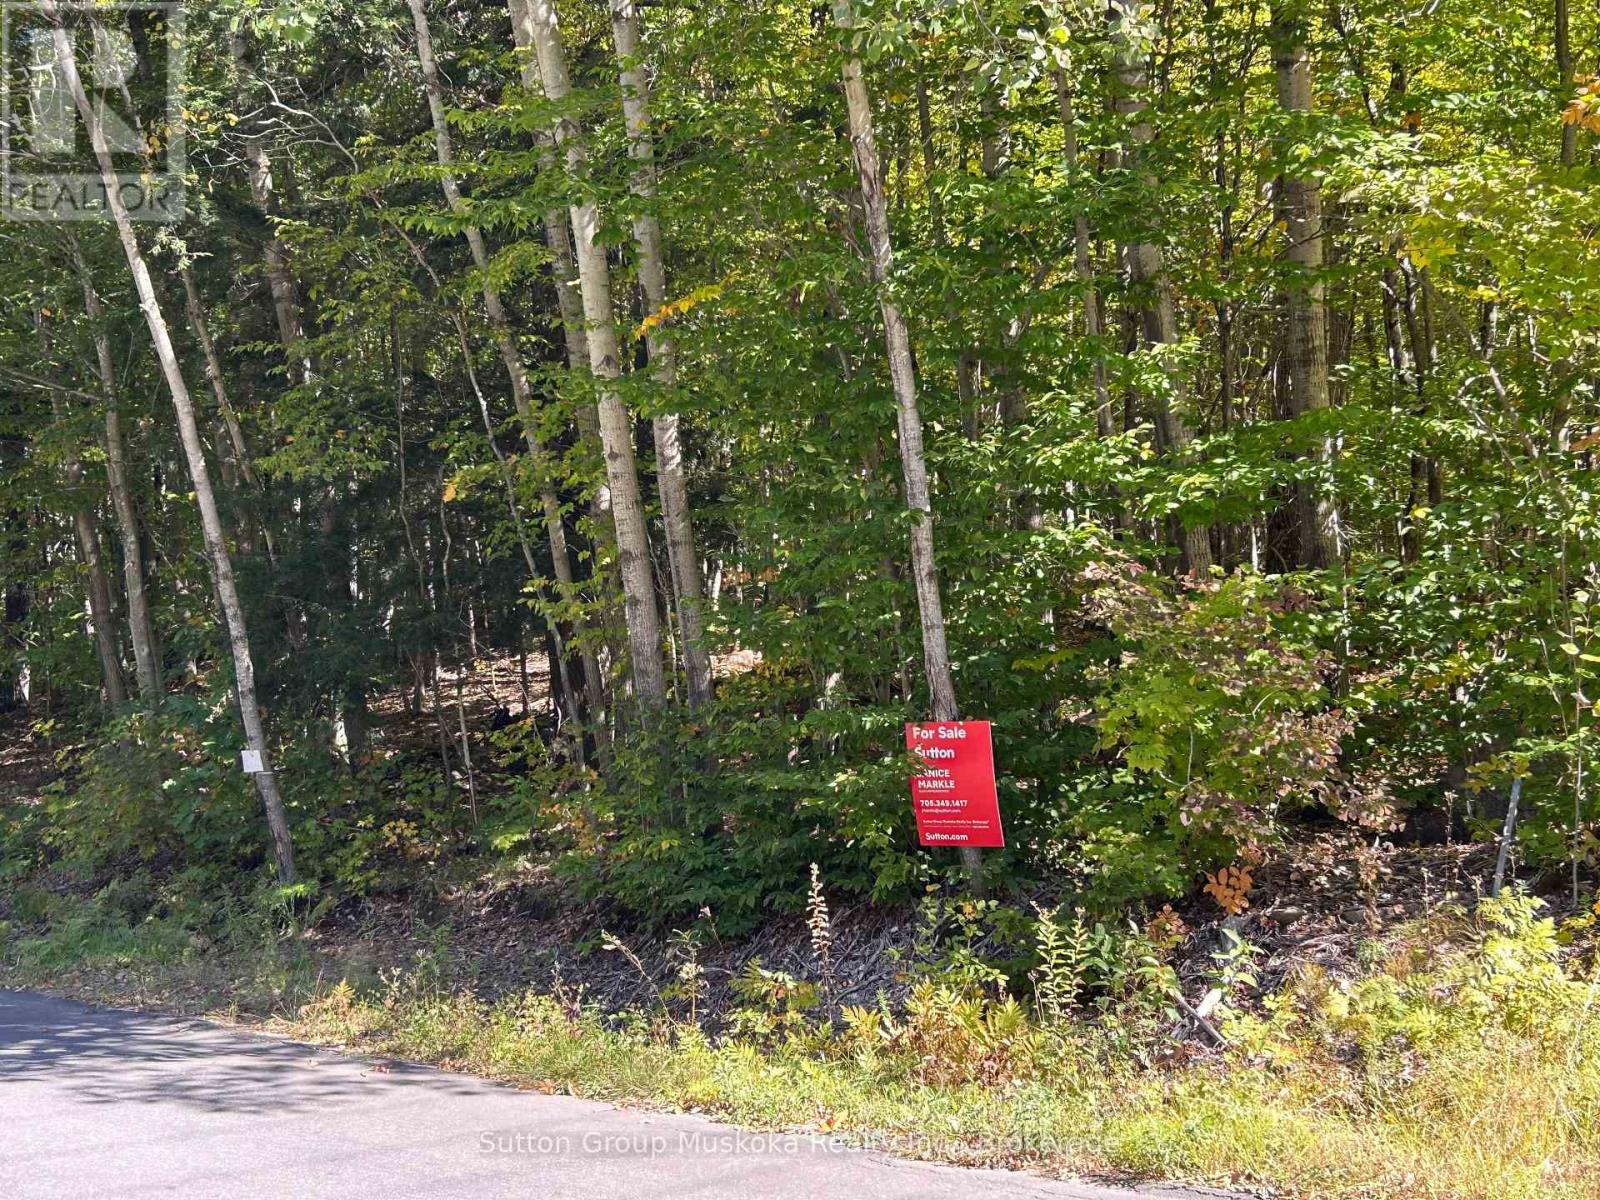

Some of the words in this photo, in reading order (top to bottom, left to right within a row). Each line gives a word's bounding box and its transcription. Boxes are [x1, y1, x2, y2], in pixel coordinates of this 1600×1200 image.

[912, 727, 935, 739] For
[938, 726, 967, 739] Sale
[918, 780, 955, 789] MARKLE
[920, 799, 967, 808] 705.349.1417
[925, 832, 968, 841] Sutton.com
